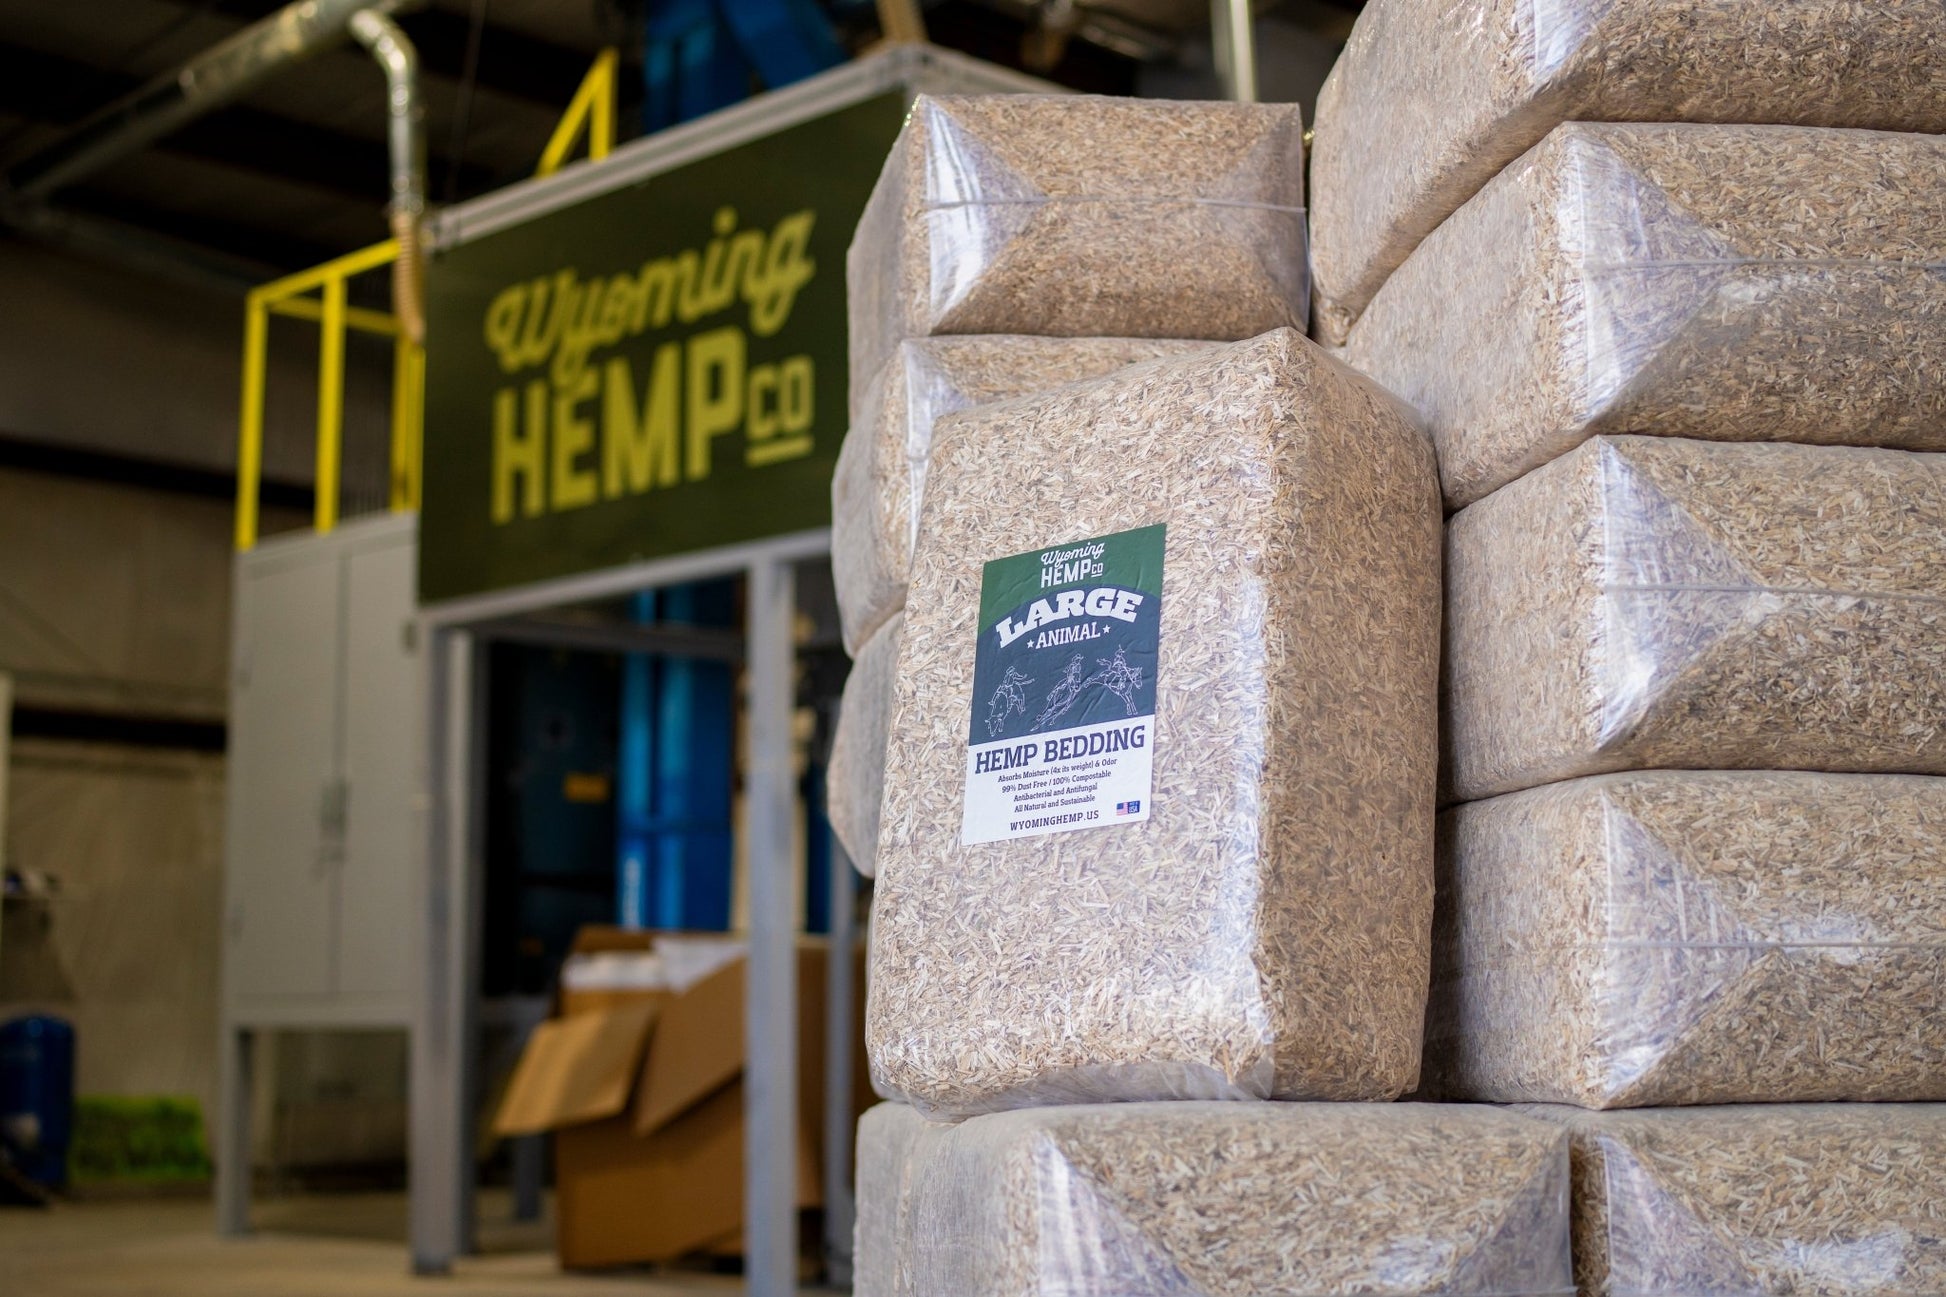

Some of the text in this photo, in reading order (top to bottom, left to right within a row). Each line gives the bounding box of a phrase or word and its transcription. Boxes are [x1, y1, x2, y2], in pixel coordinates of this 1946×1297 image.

[484, 206, 816, 393] Wyoming
[492, 325, 746, 524] HEMP
[1041, 542, 1105, 567] Wyoming
[1041, 559, 1092, 588] HEMP
[996, 587, 1143, 648] LARGE
[1036, 622, 1100, 649] ANIMAL
[975, 725, 1145, 774] HEMP BEDDING
[998, 773, 1022, 783] Absorbs
[1023, 769, 1050, 779] Moisture
[1062, 765, 1070, 773] its
[1071, 760, 1094, 771] weight)
[1102, 758, 1117, 767] Odor
[1002, 785, 1016, 793] 99%
[1018, 782, 1032, 791] Dust
[1033, 780, 1047, 789] Free
[1053, 776, 1070, 786] 100%
[1072, 770, 1111, 782] Compostable
[1014, 782, 1098, 802] Antibacterial and Antifungal
[1014, 794, 1095, 813] All Natural and Sustainable
[1010, 810, 1099, 831] WYOMINGHEMP.US
